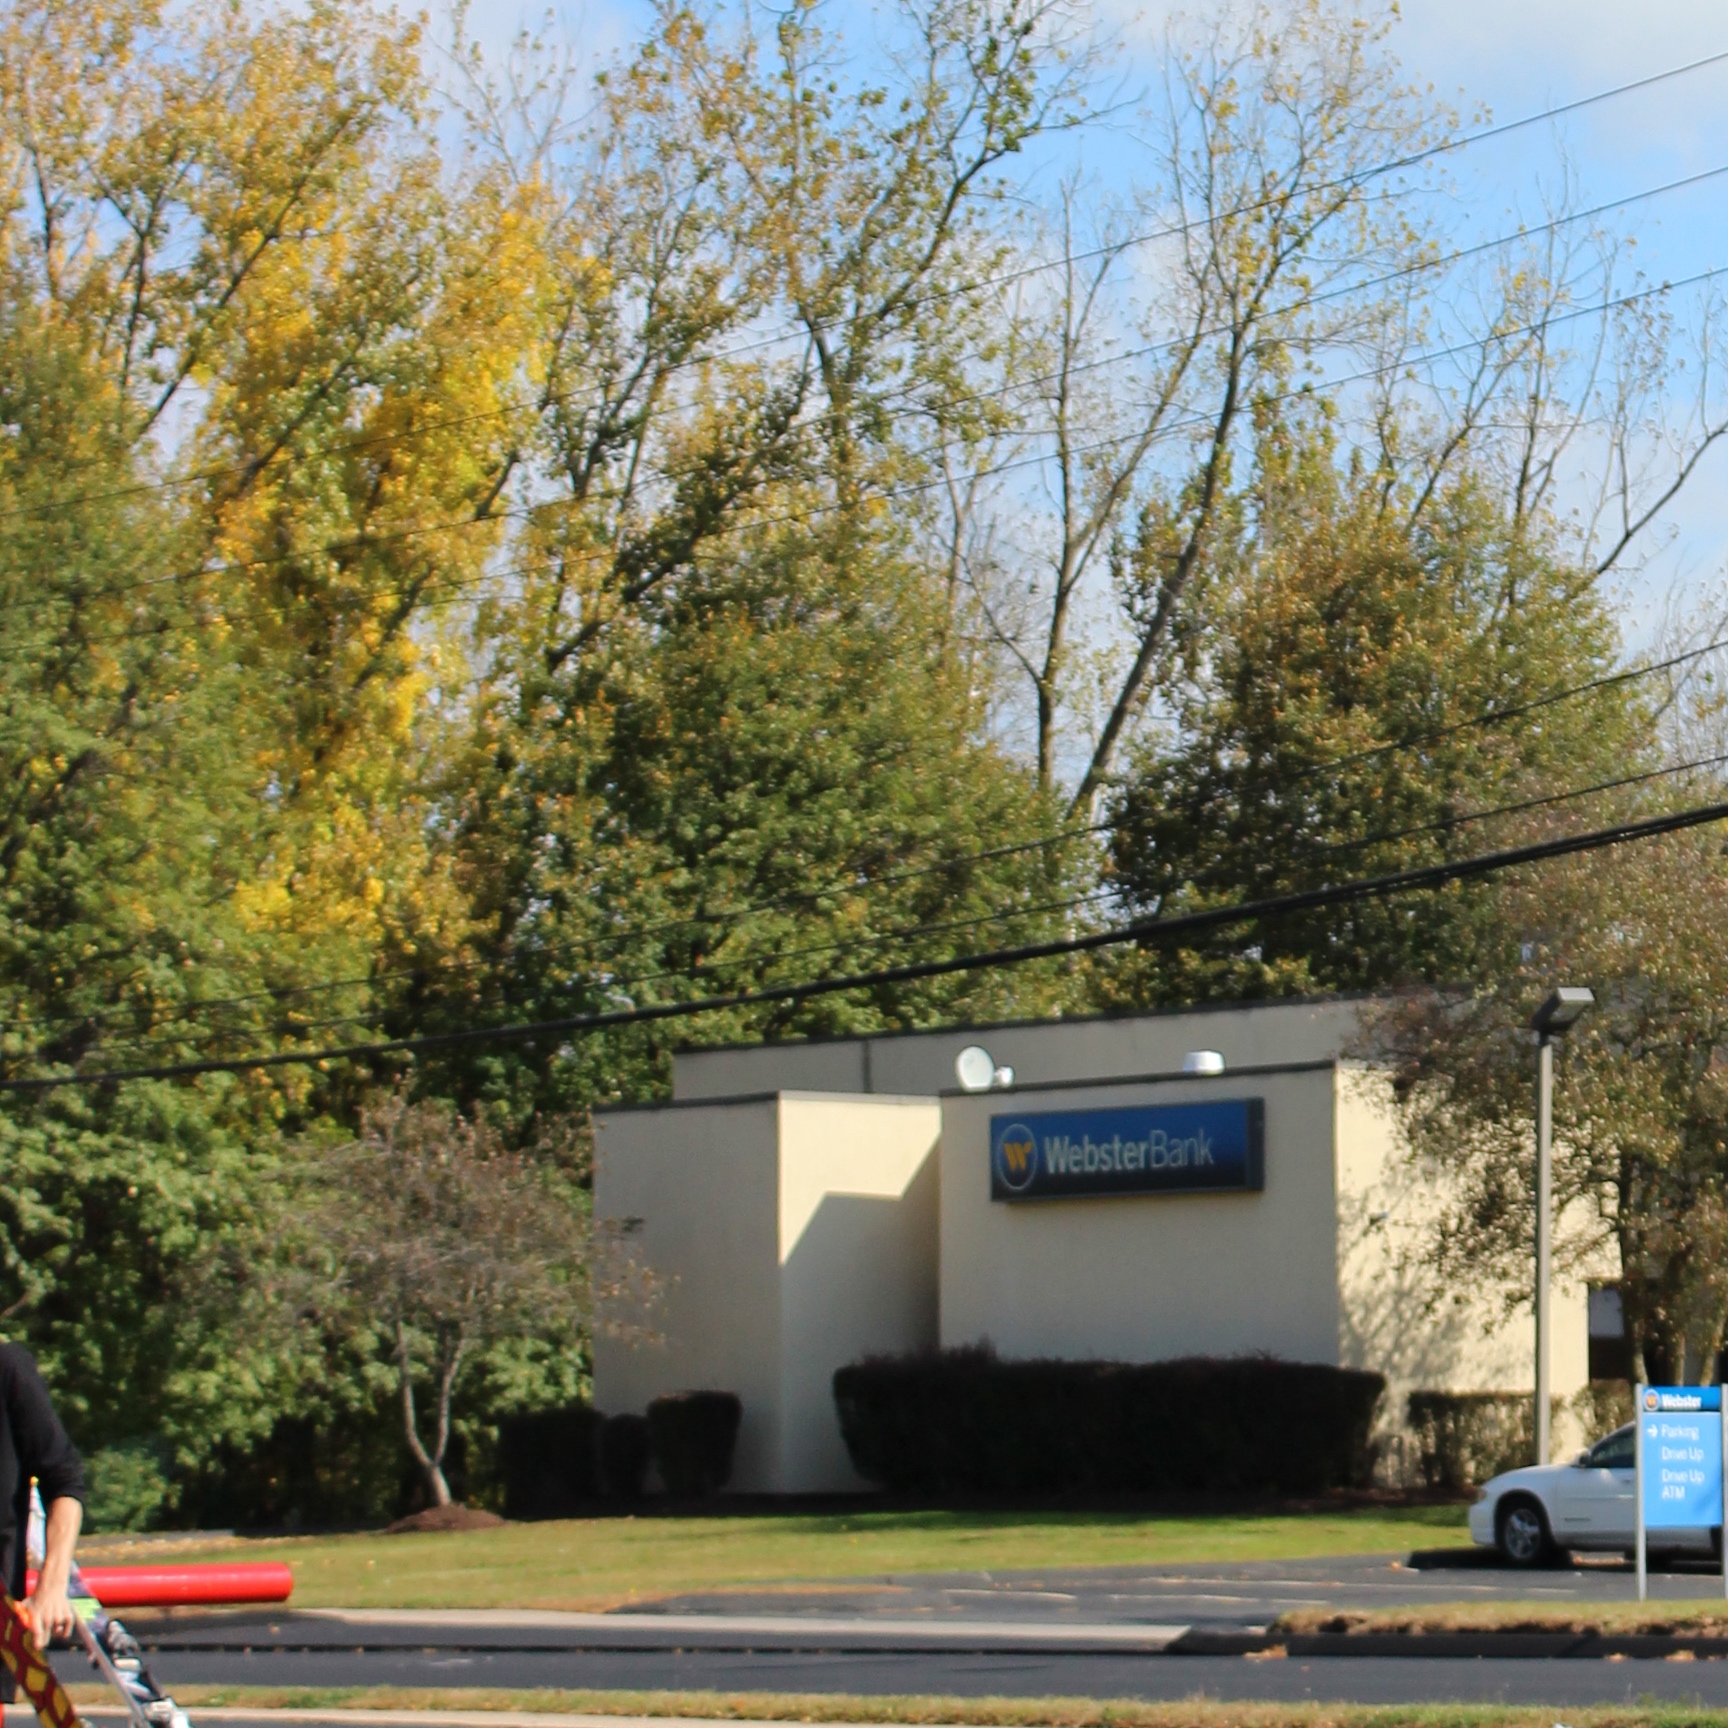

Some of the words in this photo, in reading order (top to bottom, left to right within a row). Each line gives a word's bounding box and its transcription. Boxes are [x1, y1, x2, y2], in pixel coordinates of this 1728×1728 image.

[1661, 1393, 1702, 1408] Webster
[1662, 1424, 1699, 1440] Parking
[1662, 1446, 1687, 1460] Drive
[1688, 1447, 1704, 1461] Up
[1662, 1469, 1688, 1482] Drive
[1689, 1469, 1705, 1484] Up
[1662, 1486, 1686, 1499] ATM
